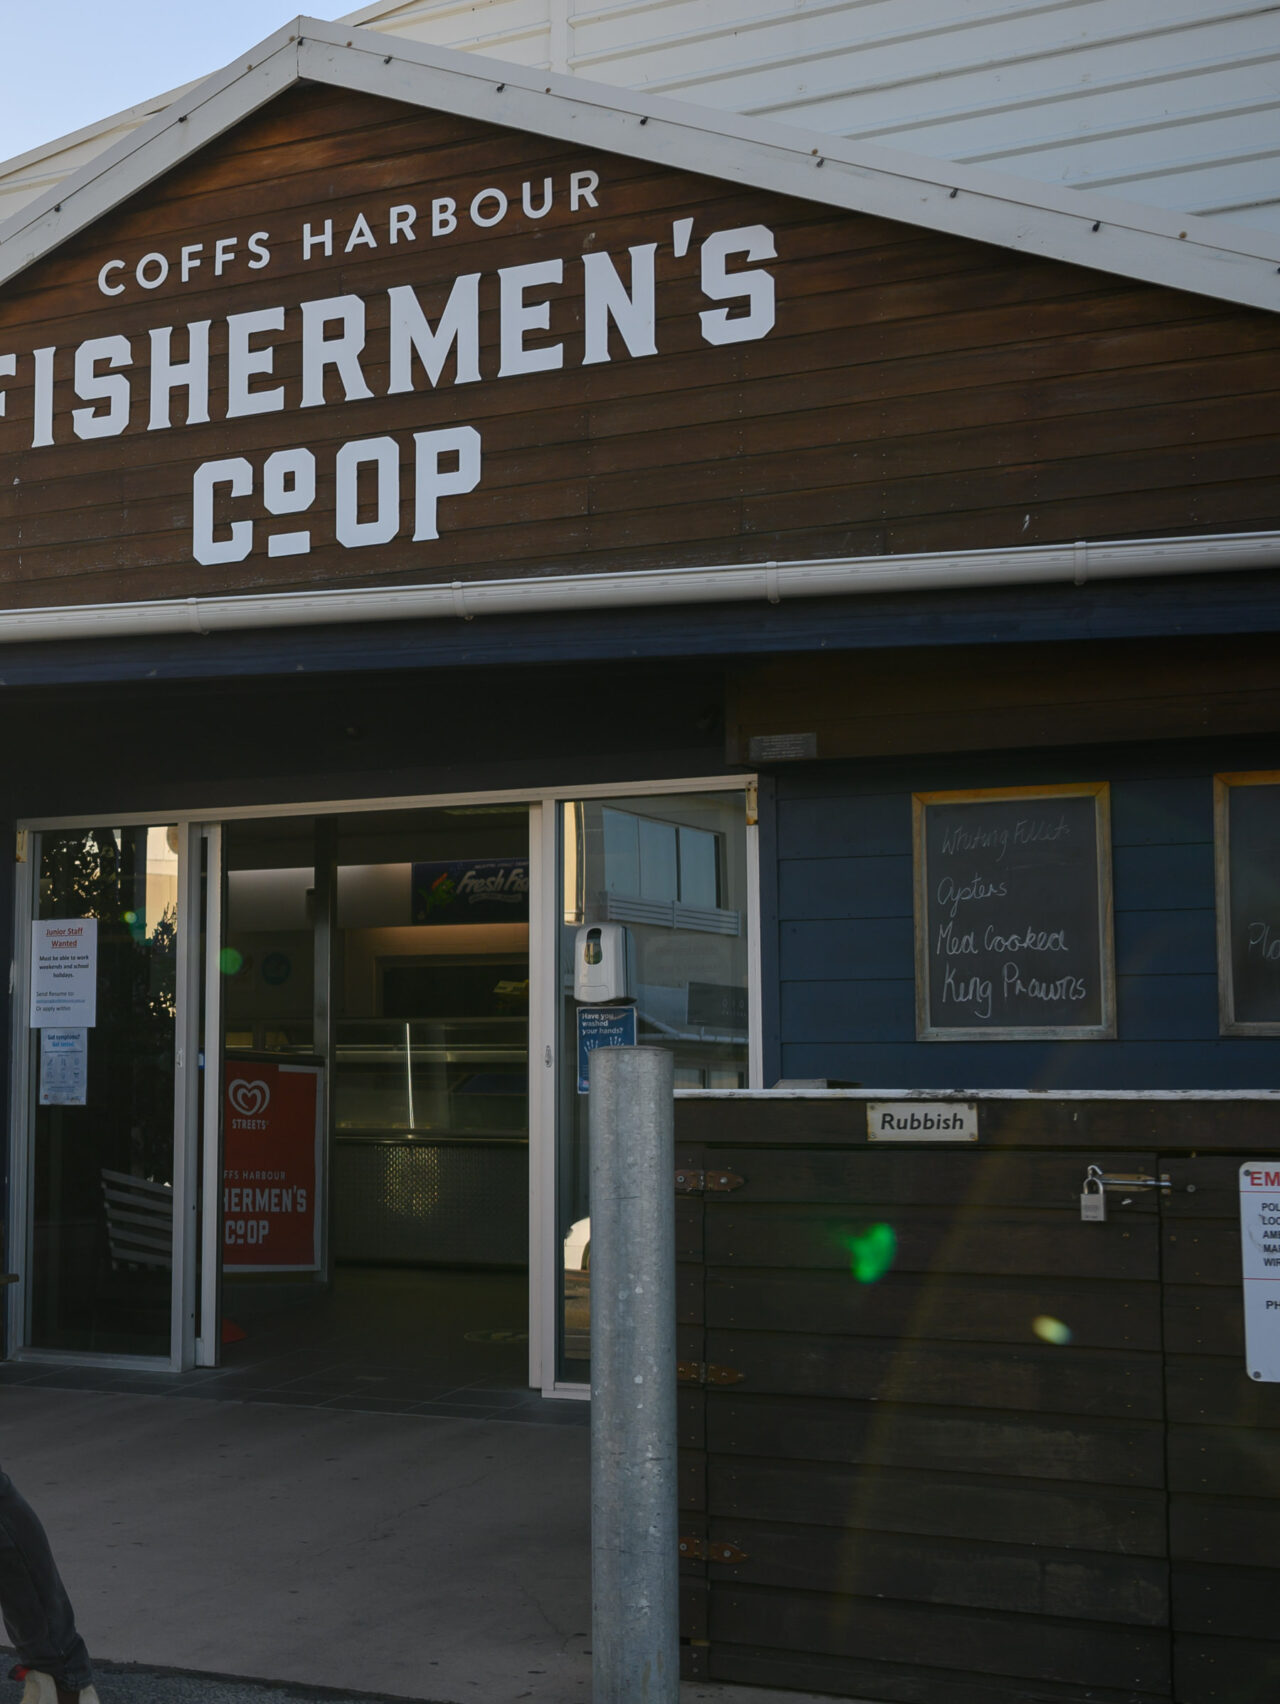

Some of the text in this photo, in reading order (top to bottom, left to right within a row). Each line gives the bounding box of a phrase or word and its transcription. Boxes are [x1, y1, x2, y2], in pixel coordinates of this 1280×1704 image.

[98, 169, 601, 296] COFFS HARBOUR
[937, 872, 1008, 918] Oysters
[46, 927, 83, 937] Junior Staff
[51, 939, 78, 948] Wanted
[937, 921, 1070, 955] Med Cooked
[942, 961, 1086, 1019] King Prawns
[581, 1012, 599, 1020] Have
[582, 1028, 598, 1036] your
[232, 1119, 267, 1130] STREETS
[880, 1112, 964, 1130] Rubbish
[242, 1170, 286, 1180] HARBOUR
